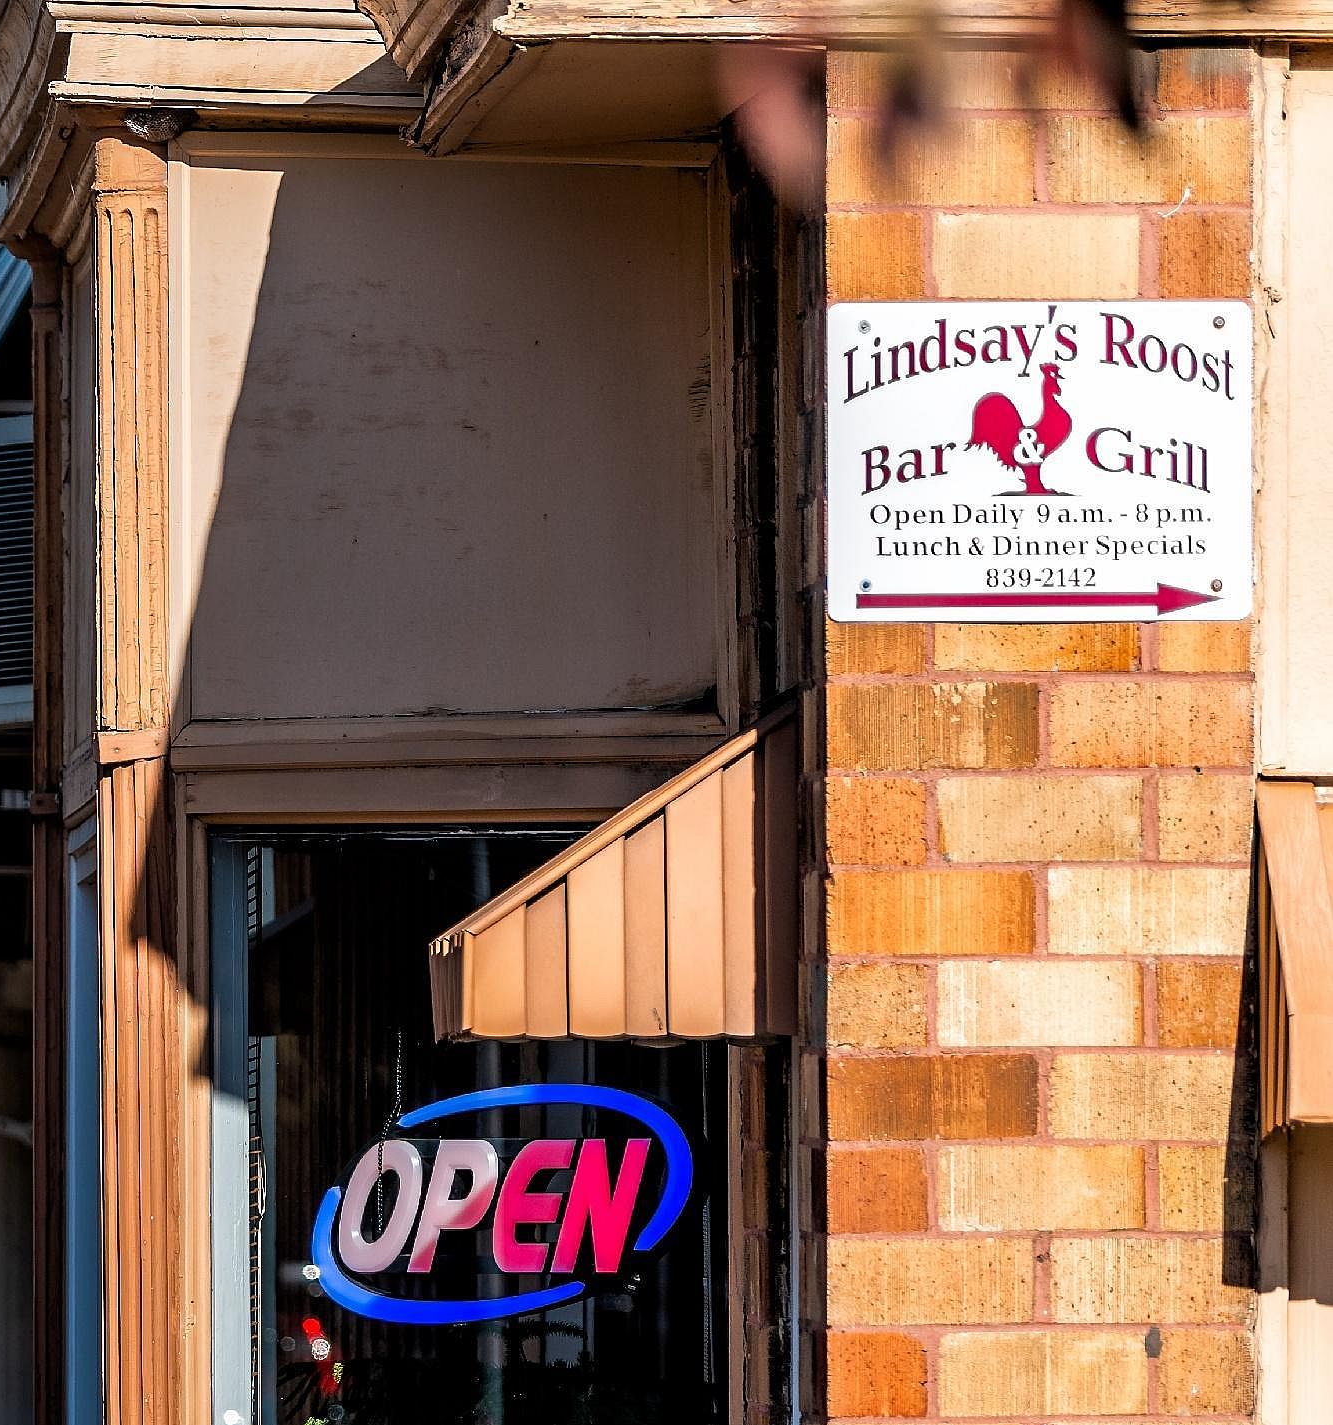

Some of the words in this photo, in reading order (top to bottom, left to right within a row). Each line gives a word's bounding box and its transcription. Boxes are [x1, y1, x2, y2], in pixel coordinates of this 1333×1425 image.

[843, 305, 1078, 404] Lindsay's
[1099, 312, 1235, 401] Roost
[861, 441, 957, 496] Bar
[1013, 427, 1046, 465] &
[1086, 427, 1211, 494] Grill
[869, 503, 946, 530] Open
[952, 502, 1025, 530] Daily
[1036, 503, 1051, 524] 9
[1135, 503, 1150, 523] 8
[875, 535, 963, 557] Lunch
[967, 536, 985, 557] &
[992, 535, 1090, 557] Dinner
[1095, 534, 1207, 560] Specials
[986, 567, 1097, 588] 839-2142
[338, 1138, 652, 1274] OPEN
